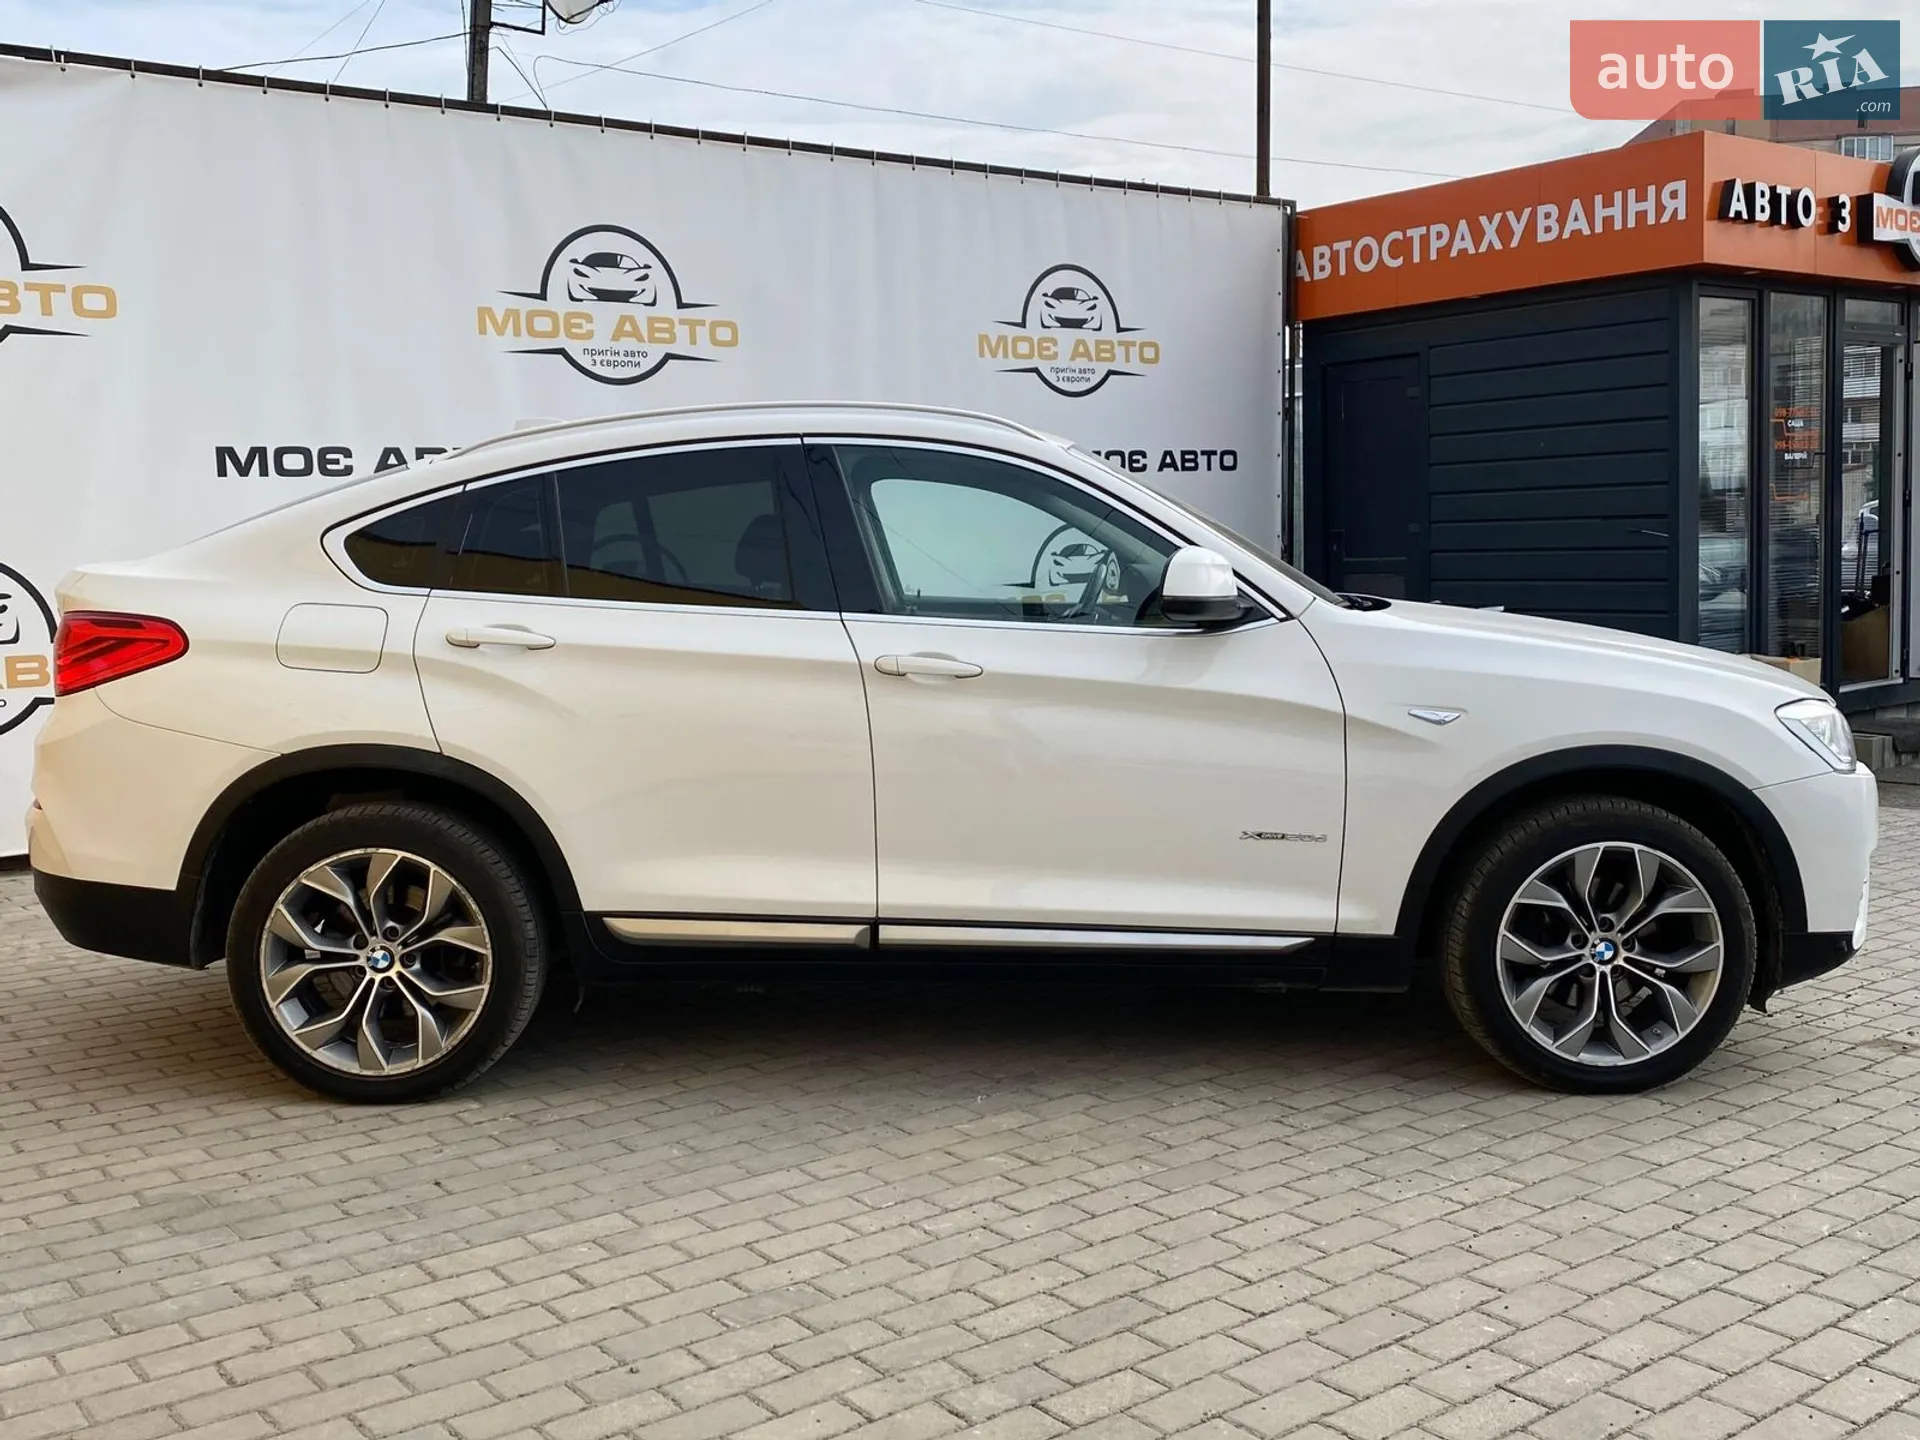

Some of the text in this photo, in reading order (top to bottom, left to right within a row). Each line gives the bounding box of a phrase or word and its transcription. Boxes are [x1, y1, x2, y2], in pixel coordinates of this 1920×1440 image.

[1728, 177, 1816, 228] АВТО
[1295, 180, 1687, 283] АВТОСТРАХУВАННЯ
[476, 306, 739, 348] МОЄ АВТО
[583, 347, 648, 358] пригін авто
[600, 359, 641, 369] європи
[977, 333, 1161, 365] МОЄ АВТО
[215, 446, 353, 477] МОЄ
[1157, 449, 1238, 473] АВТО
